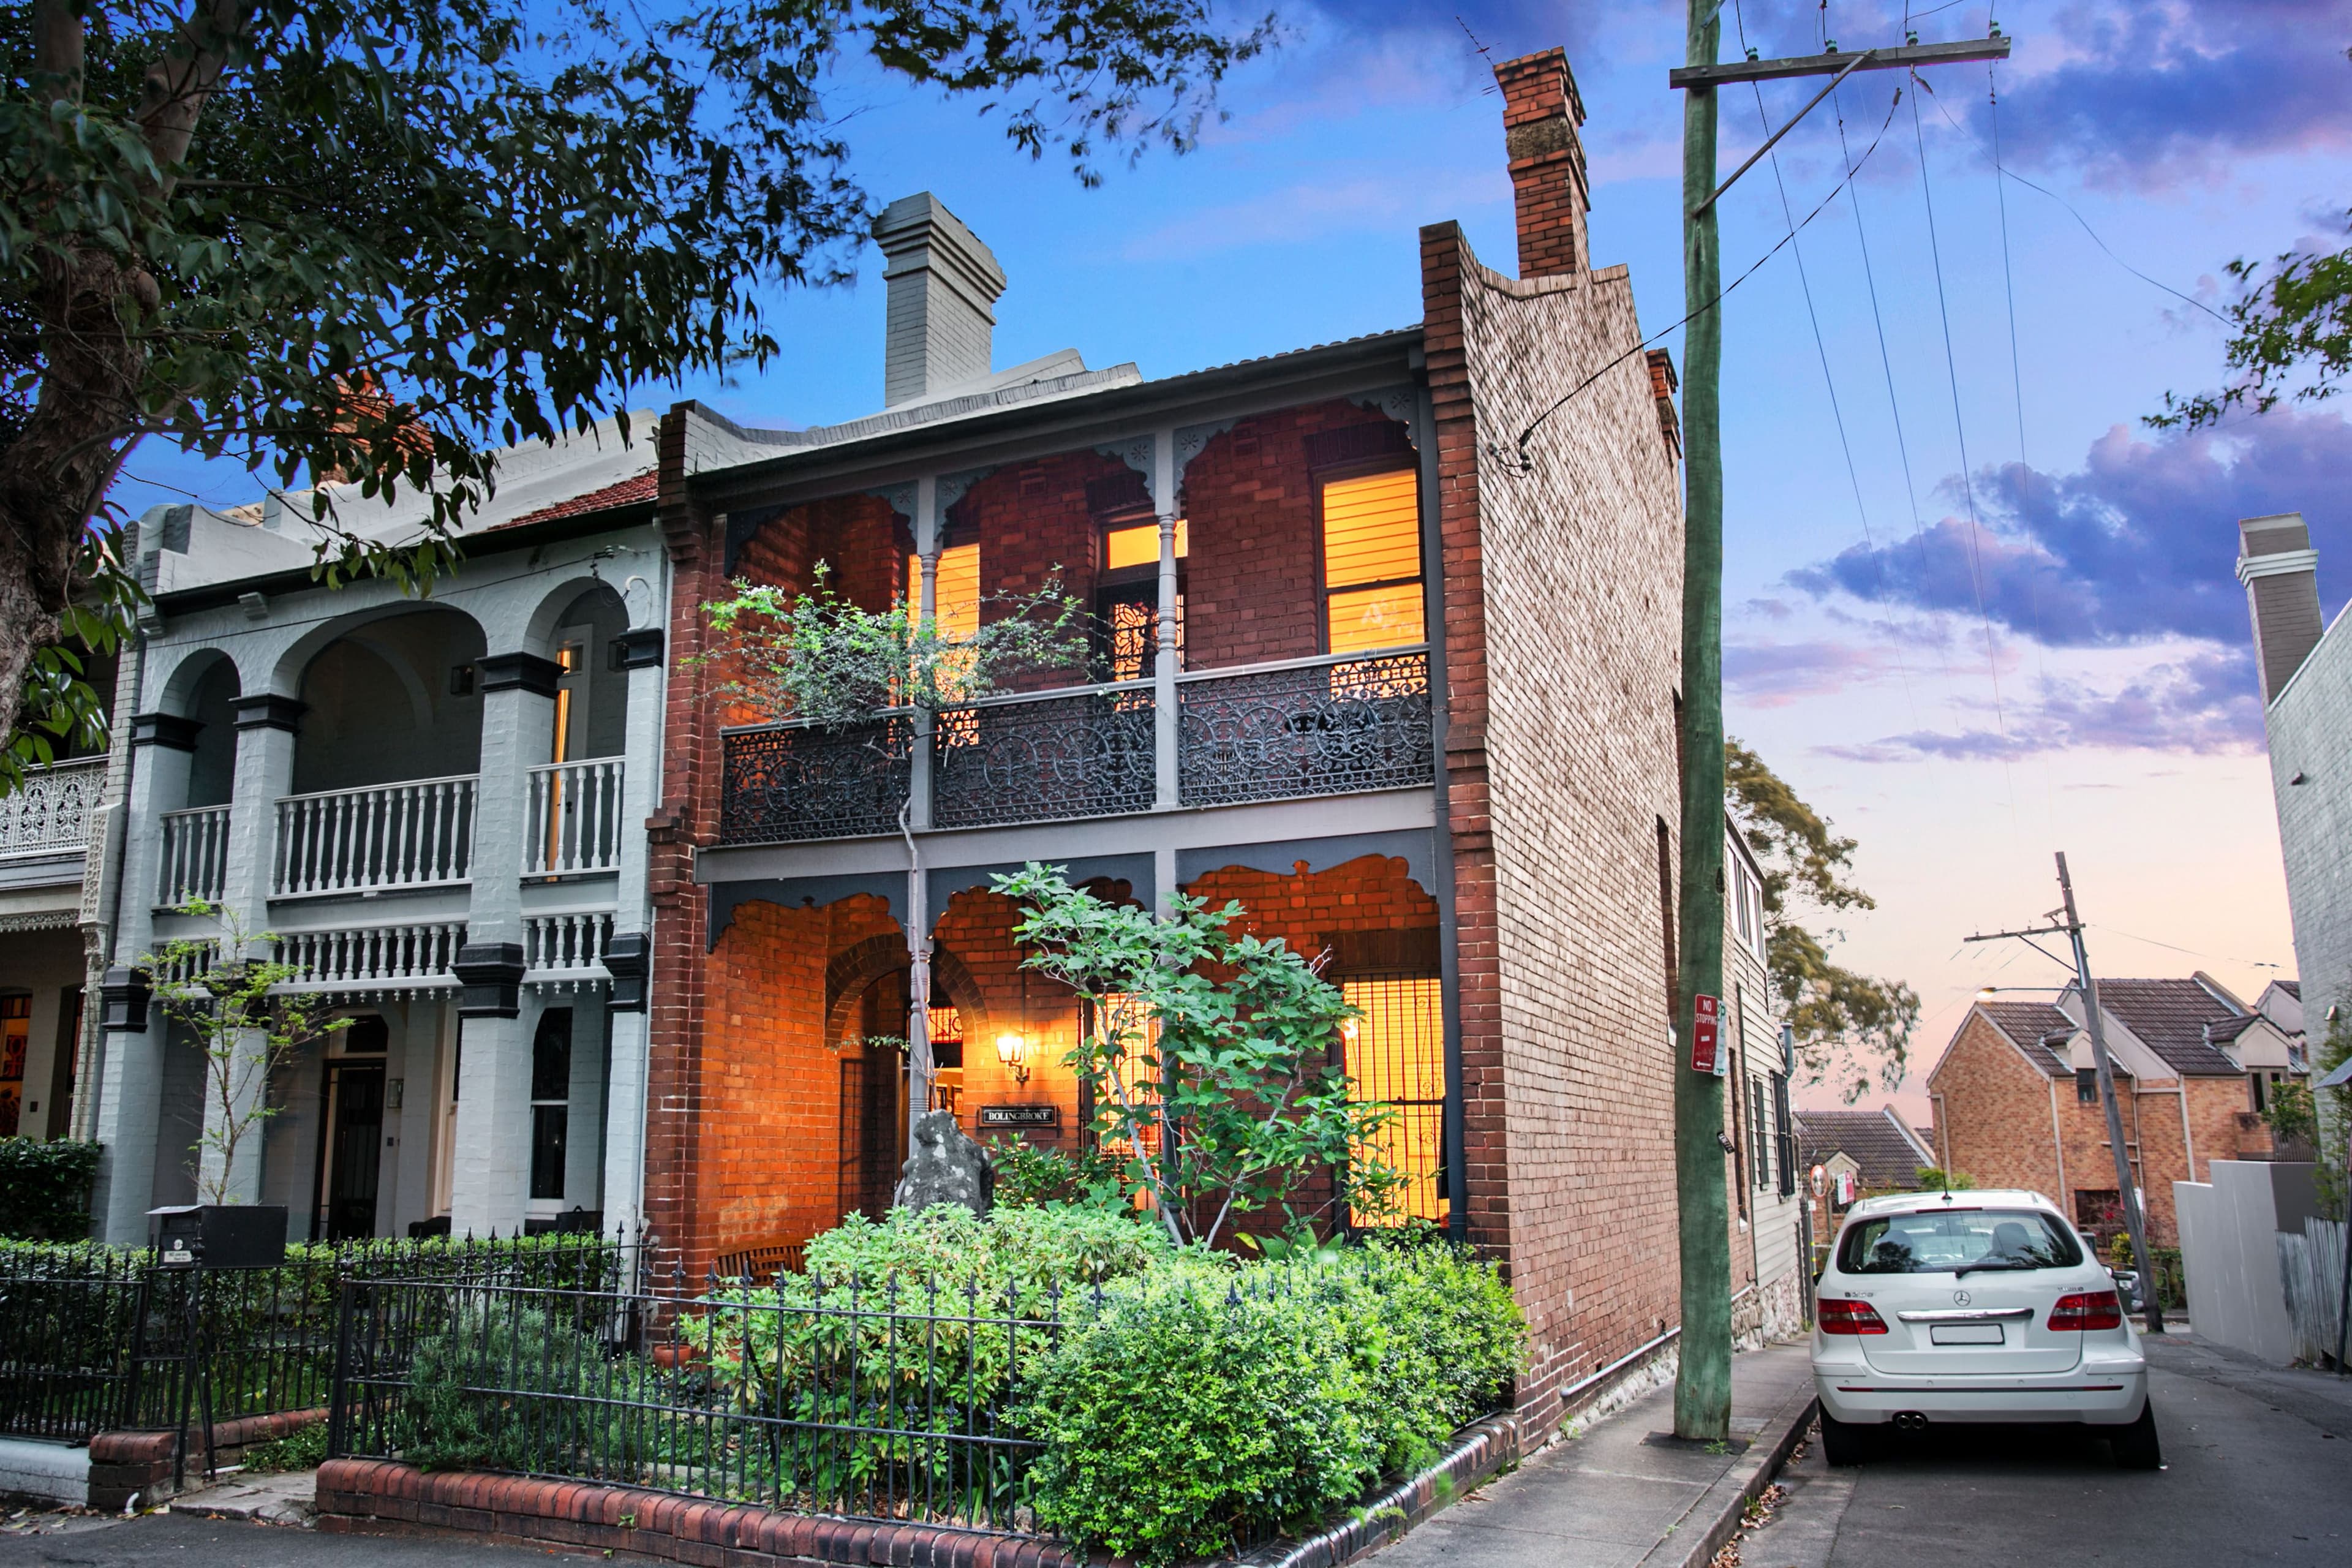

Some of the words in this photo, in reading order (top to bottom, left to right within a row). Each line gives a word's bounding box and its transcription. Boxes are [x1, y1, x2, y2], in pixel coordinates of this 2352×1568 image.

[1703, 1000, 1712, 1012] NO
[1696, 1013, 1717, 1025] STOPPING
[989, 1112, 1049, 1120] BOLINGBROKE
